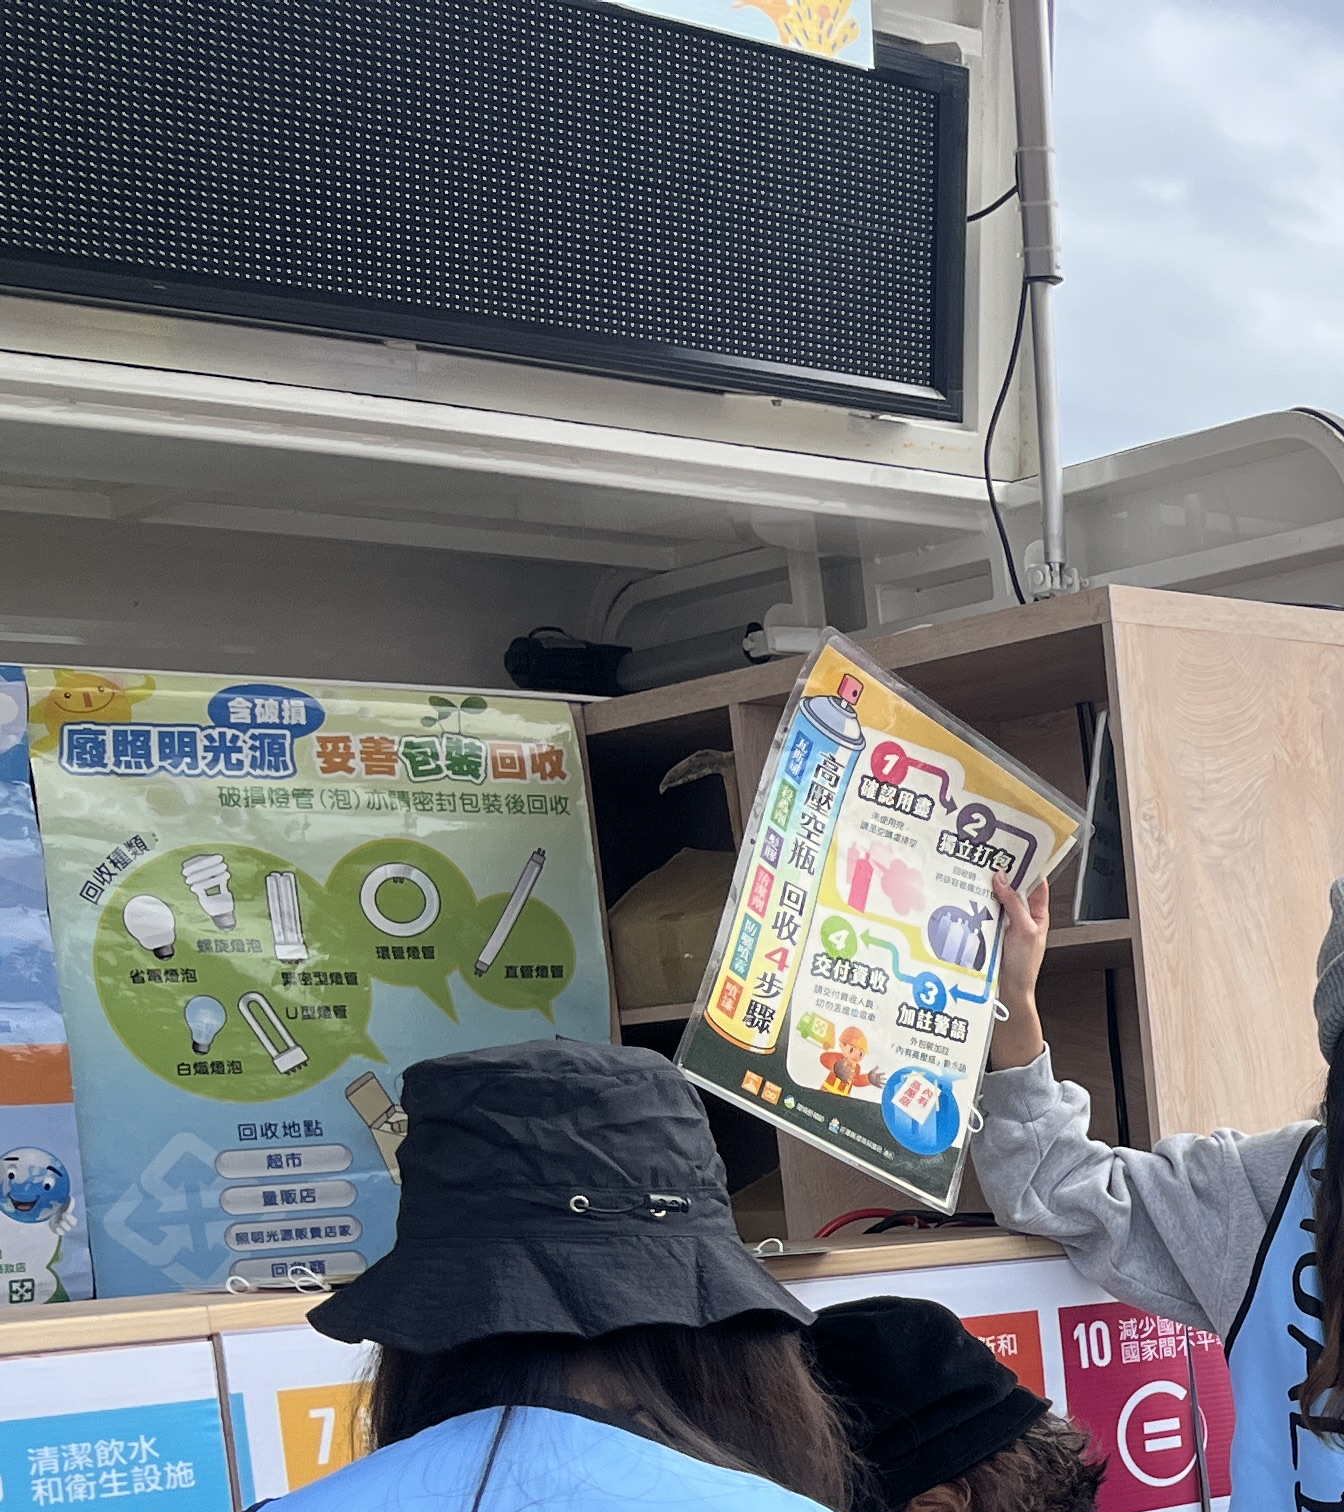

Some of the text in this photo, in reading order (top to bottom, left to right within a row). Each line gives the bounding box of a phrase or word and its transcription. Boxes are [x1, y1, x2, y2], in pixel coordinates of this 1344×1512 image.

[227, 697, 308, 726] 含破損
[65, 727, 292, 776] 廢照明光源
[316, 735, 569, 784] 妥善包裝回收
[881, 753, 900, 776] 1
[787, 752, 846, 876] 高壓空瓶
[962, 812, 988, 839] 2
[827, 928, 850, 951] 4
[811, 953, 889, 995] 交付資收
[919, 981, 939, 1005] 3
[896, 1002, 968, 1043] 加註警語
[237, 1119, 324, 1142] 回收地點
[265, 1152, 303, 1170] 超市
[261, 1187, 317, 1207] 量販店
[1073, 1320, 1112, 1369] 10
[27, 1434, 160, 1477] 清潔飲水
[308, 1407, 335, 1465] 7
[31, 1460, 196, 1507] 和衛生設施
